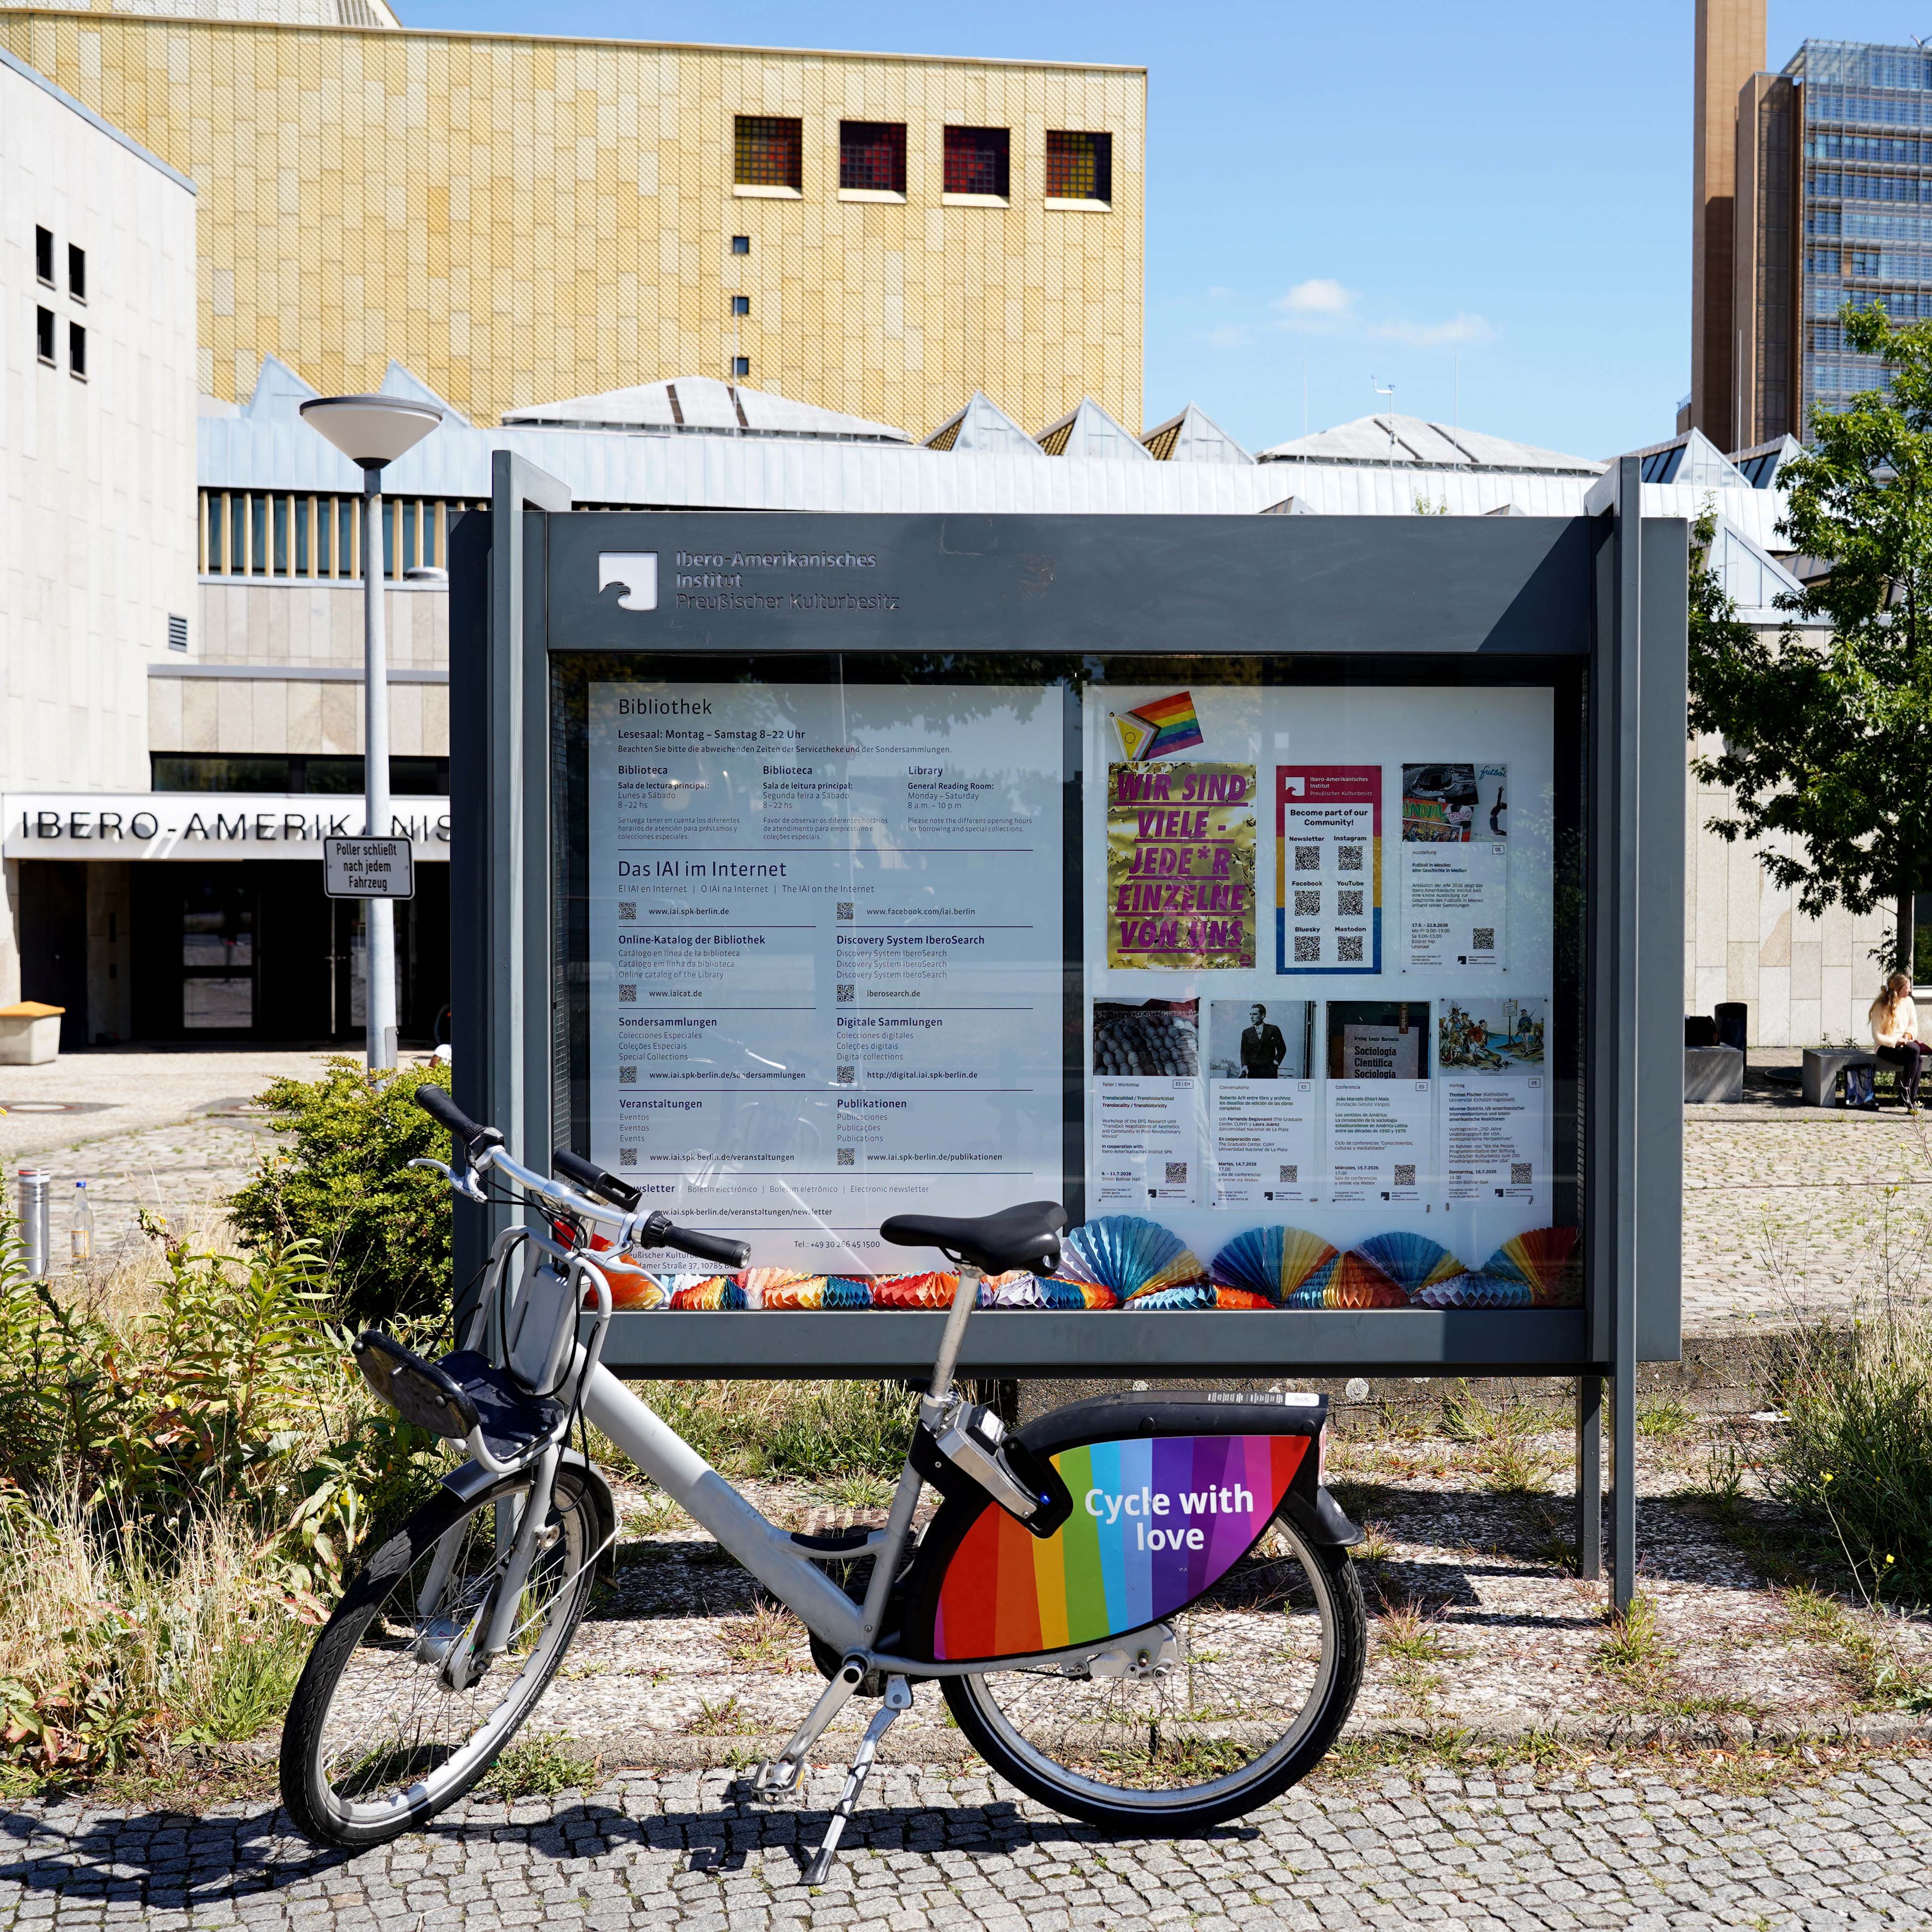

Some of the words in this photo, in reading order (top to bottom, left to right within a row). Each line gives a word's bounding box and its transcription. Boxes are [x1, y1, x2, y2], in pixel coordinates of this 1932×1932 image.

[676, 551, 877, 567] Ibero-Amerikanisches
[676, 572, 742, 588] Institut
[676, 593, 784, 610] Preußischer
[790, 593, 900, 610] Kulturbesitz
[619, 698, 712, 715] Bibliothek
[618, 729, 663, 739] Lesesaal:
[666, 729, 704, 741] Montag
[714, 730, 757, 741] Samstag
[759, 730, 784, 739] 8–22
[787, 730, 805, 739] Uhr
[875, 746, 952, 755] Sondersammlungen.
[618, 765, 667, 774] Biblioteca
[763, 765, 812, 775] Biblioteca
[909, 765, 943, 777] Library
[674, 782, 709, 791] principal:
[818, 782, 853, 791] principal:
[938, 782, 969, 791] Reading
[1117, 774, 1171, 801] WIR
[1182, 774, 1248, 801] SIND
[763, 791, 795, 801] Segunda
[908, 792, 938, 801] Monday
[945, 792, 979, 801] Saturday
[1325, 809, 1342, 818] part
[22, 811, 450, 842] IBERO-AMERIKNIS
[1137, 811, 1209, 837] VIELE
[1304, 819, 1354, 828] Community!
[336, 843, 360, 855] Poller
[363, 843, 398, 856] schließt
[343, 859, 363, 872] nach
[365, 860, 391, 874] jedem
[619, 861, 651, 877] Das
[657, 861, 678, 876] IAI
[685, 861, 706, 877] im
[713, 861, 787, 877] Internet
[349, 876, 388, 892] Fahrzeug
[1117, 885, 1246, 911] EINZELNE
[649, 907, 729, 916] www.iai.spk-berlin.de
[866, 907, 975, 916] www.facebook.com/iai.berlin
[1120, 921, 1178, 948] VON
[1189, 920, 1244, 948] UNS
[618, 935, 693, 947] Online-Katalog
[695, 935, 711, 944] der
[714, 935, 765, 944] Bibliothek
[837, 935, 884, 947] Discovery
[887, 935, 923, 947] System
[926, 935, 985, 944] IberoSearch
[645, 970, 672, 980] catalog
[698, 970, 724, 980] Library
[619, 1017, 717, 1029] Sondersammlungen
[837, 1017, 876, 1029] Digitale
[878, 1017, 942, 1029] Sammlungen
[1354, 1045, 1397, 1057] Sociología
[619, 1053, 645, 1062] Special
[837, 1053, 861, 1062] Digital
[1354, 1056, 1393, 1067] Científica
[649, 1071, 805, 1080] www.iai.spk-berlin.de/sondersammlungen
[867, 1071, 978, 1080] http://digital.iai.spk-berlin.de
[1354, 1069, 1397, 1080] Sociología
[619, 1099, 702, 1110] Veranstaltungen
[837, 1099, 907, 1108] Publikationen
[650, 1153, 794, 1162] www.iai.spk-berlin.de/veranstaltungen
[867, 1153, 1002, 1162] www.iai.spk-berlin.de/publikationen
[1085, 1486, 1170, 1524] Cycle
[1179, 1483, 1254, 1515] with
[1137, 1522, 1204, 1551] love
